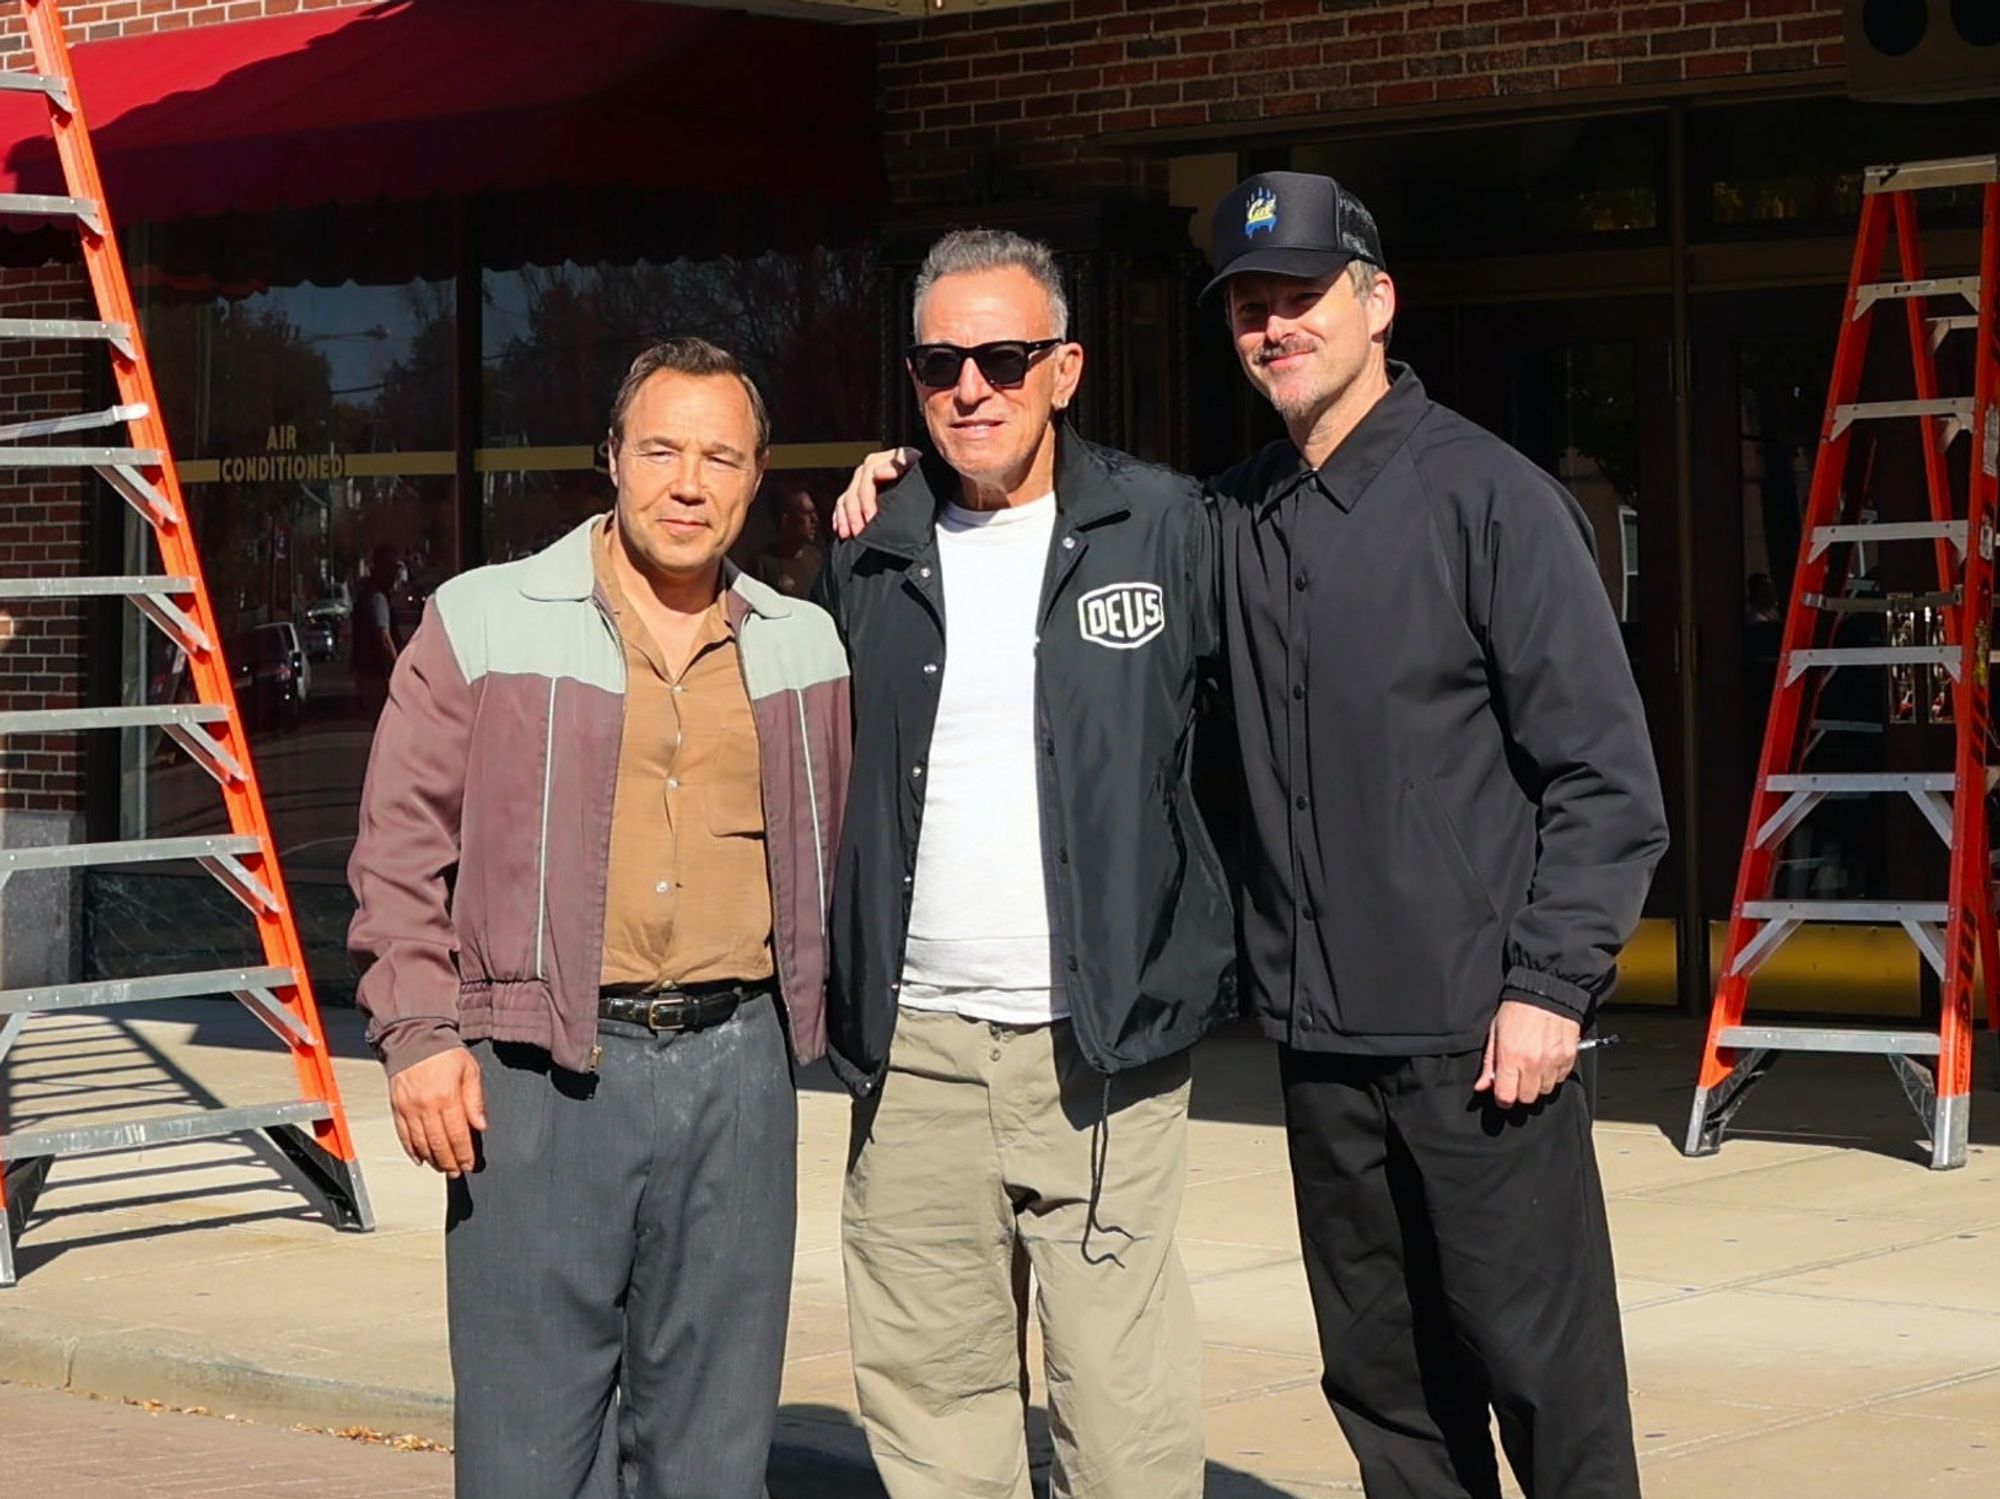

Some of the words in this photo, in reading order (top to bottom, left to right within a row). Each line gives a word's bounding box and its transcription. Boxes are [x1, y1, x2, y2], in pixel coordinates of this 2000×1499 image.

[266, 424, 297, 450] AIR
[222, 454, 343, 482] CONDITIONED
[1087, 590, 1160, 639] DEUS
